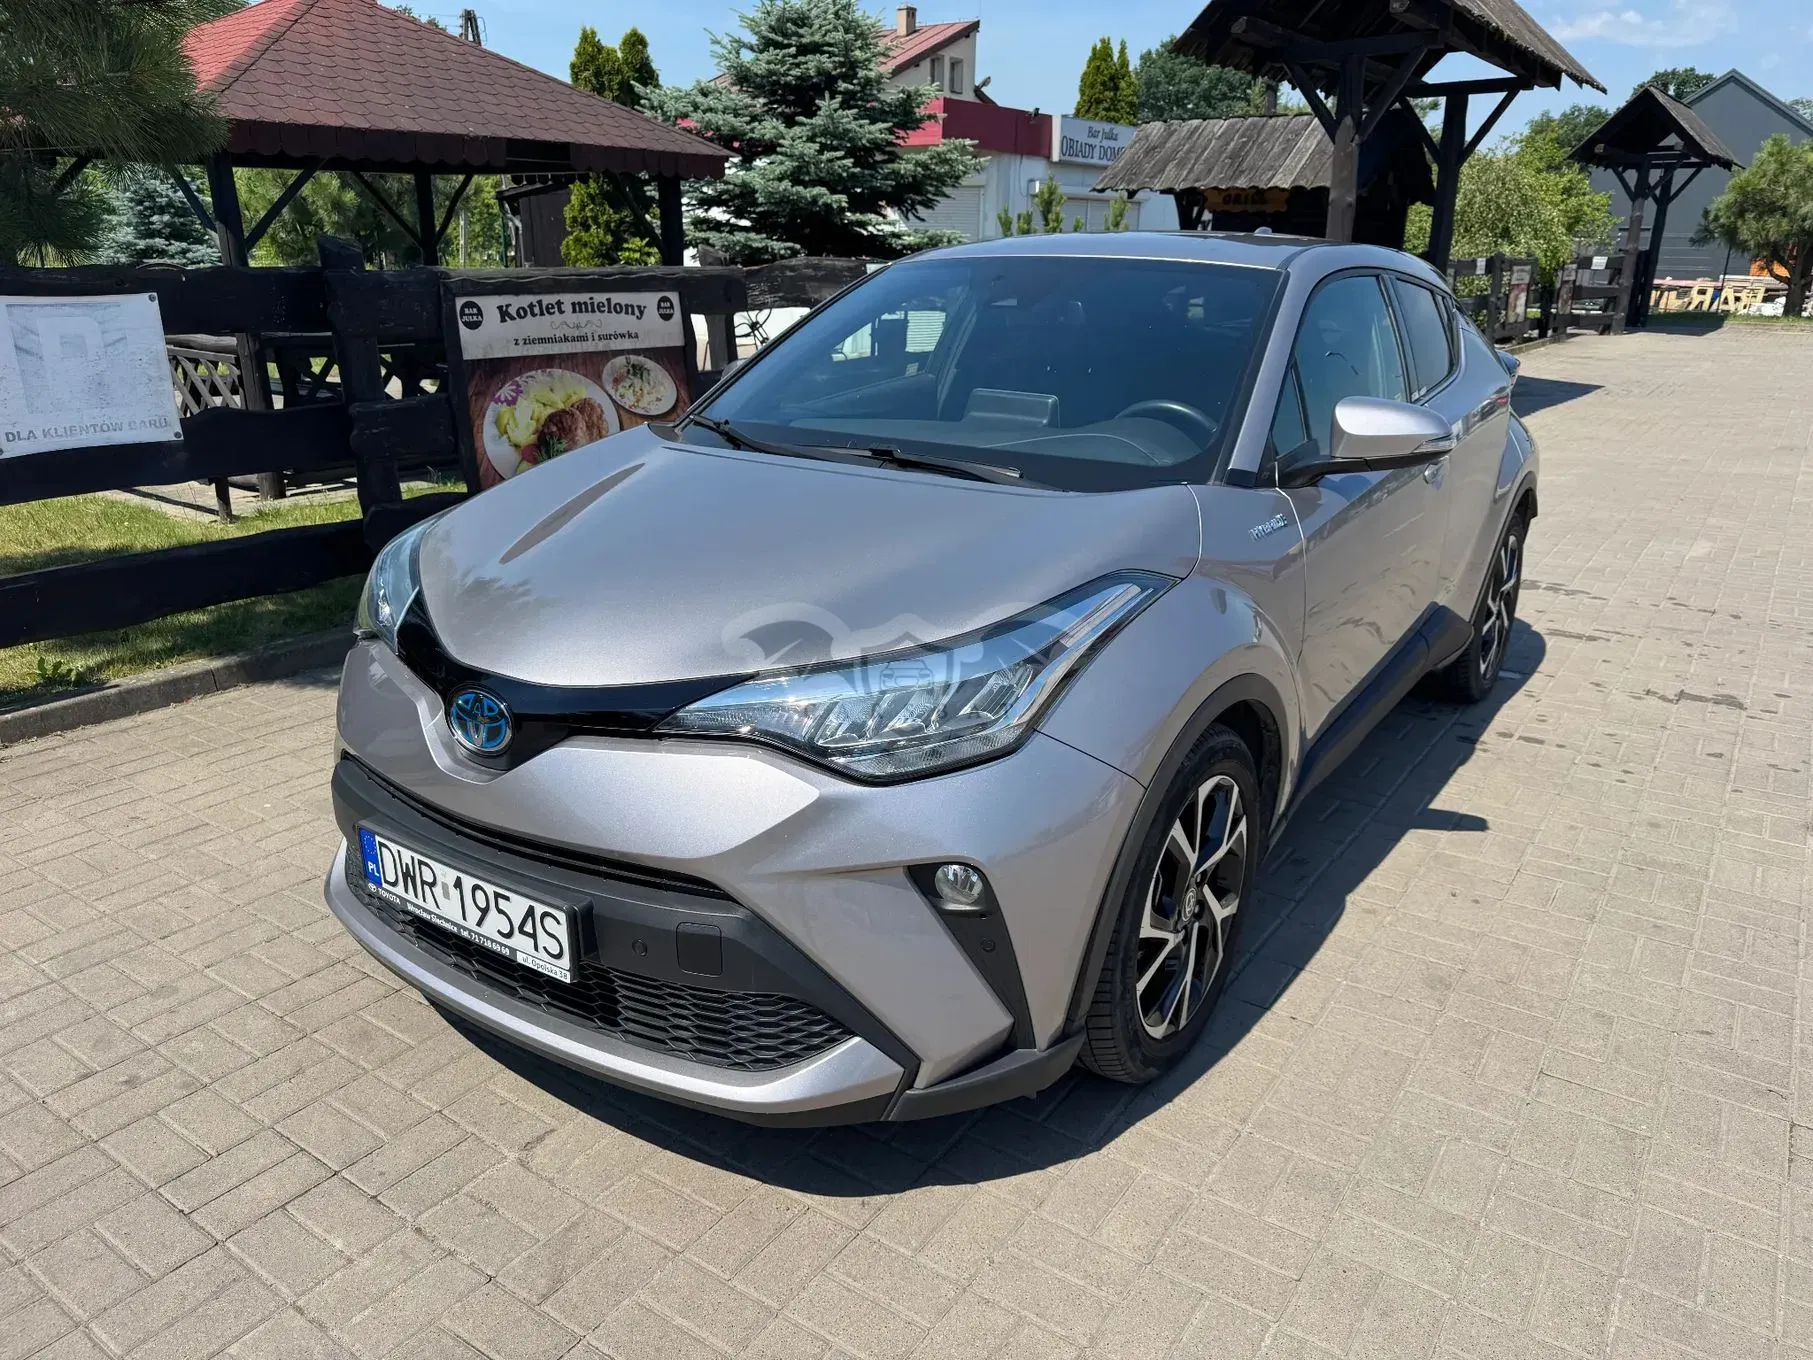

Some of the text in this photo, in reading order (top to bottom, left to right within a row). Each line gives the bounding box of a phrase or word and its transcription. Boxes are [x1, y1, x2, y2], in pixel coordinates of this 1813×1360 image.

[1087, 126, 1100, 139] Bar
[1061, 135, 1097, 159] OBIADY
[496, 297, 647, 324] Kotlet mielony
[513, 338, 520, 346] z
[522, 332, 589, 345] ziemniakami
[5, 429, 37, 442] DLA
[42, 421, 124, 439] KLIENTÓW
[368, 861, 380, 877] PL
[377, 841, 564, 960] DWR 1954S
[378, 888, 401, 904] TOYOTA
[522, 956, 531, 965] ul.
[559, 971, 568, 980] 38
